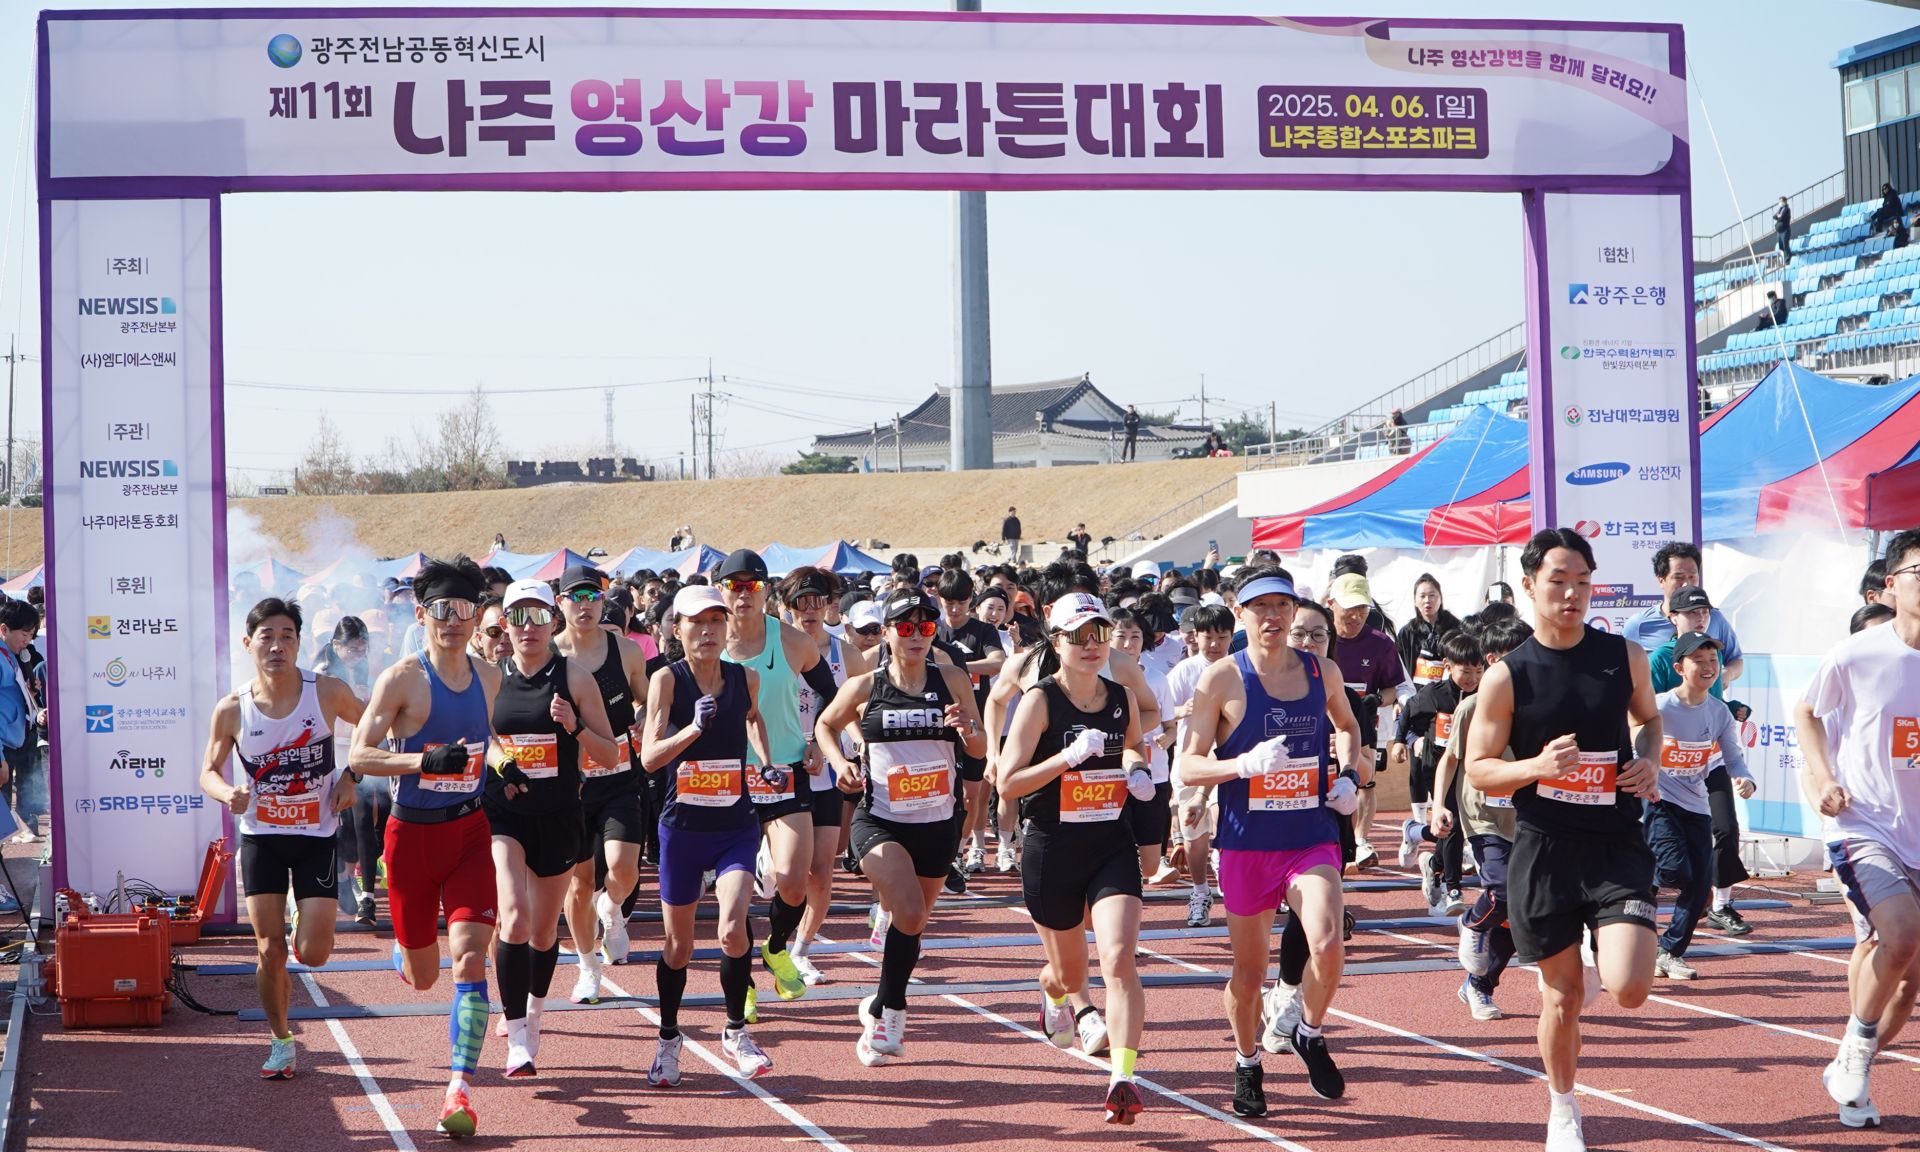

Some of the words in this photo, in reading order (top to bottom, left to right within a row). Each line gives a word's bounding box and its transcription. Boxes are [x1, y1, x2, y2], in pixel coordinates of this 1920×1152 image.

[311, 36, 545, 65] 광주전남공동혁신도시
[1407, 47, 1444, 66] 나주
[1451, 48, 1542, 70] 영산강변을
[1549, 53, 1585, 78] 함께
[1591, 64, 1658, 105] 달려요!!
[1268, 94, 1339, 118] 2025.
[1344, 94, 1385, 118] 04.
[1390, 94, 1430, 118] 06.
[1435, 94, 1476, 119] [일]
[269, 81, 372, 119] 제11회
[393, 79, 556, 157] 나주
[570, 78, 814, 157] 영산강
[833, 80, 1224, 159] 마라톤대회
[1269, 125, 1477, 150] 나주종합스포츠파크
[1603, 247, 1629, 264] 협찬
[112, 257, 142, 275] 주최
[1592, 286, 1666, 306] 광주은행
[78, 298, 158, 315] NEWSIS
[120, 321, 176, 334] 광주전남본부
[81, 352, 176, 369] (사)엠디에스앤씨
[1587, 408, 1680, 423] 전남대학교병원
[113, 423, 143, 440] 주관
[80, 460, 160, 478] NEWSIS
[1573, 468, 1624, 479] SAMSUNG
[1638, 466, 1681, 480] 삼성전자
[122, 484, 178, 496] 광주전남본부
[82, 514, 178, 530] 나주마라톤동호회
[1604, 520, 1676, 536] 한국전력
[116, 577, 146, 595] 후원
[116, 618, 178, 635] 전라남도
[142, 666, 176, 680] 나주시
[117, 707, 186, 718] 광주광역시교육청
[1896, 719, 1915, 727] 5Km
[252, 744, 324, 768] 광주철인클럽
[1668, 750, 1703, 763] 5579
[109, 757, 166, 778] 사랑방
[1560, 767, 1606, 784] 540
[689, 773, 730, 788] 6291
[899, 773, 940, 793] 6527
[1063, 774, 1079, 782] 5Km
[1263, 772, 1310, 790] 5284
[1072, 784, 1116, 802] 6427
[1565, 792, 1600, 803] 광주은행
[267, 805, 307, 819] 5001
[1276, 800, 1307, 809] 광주은행
